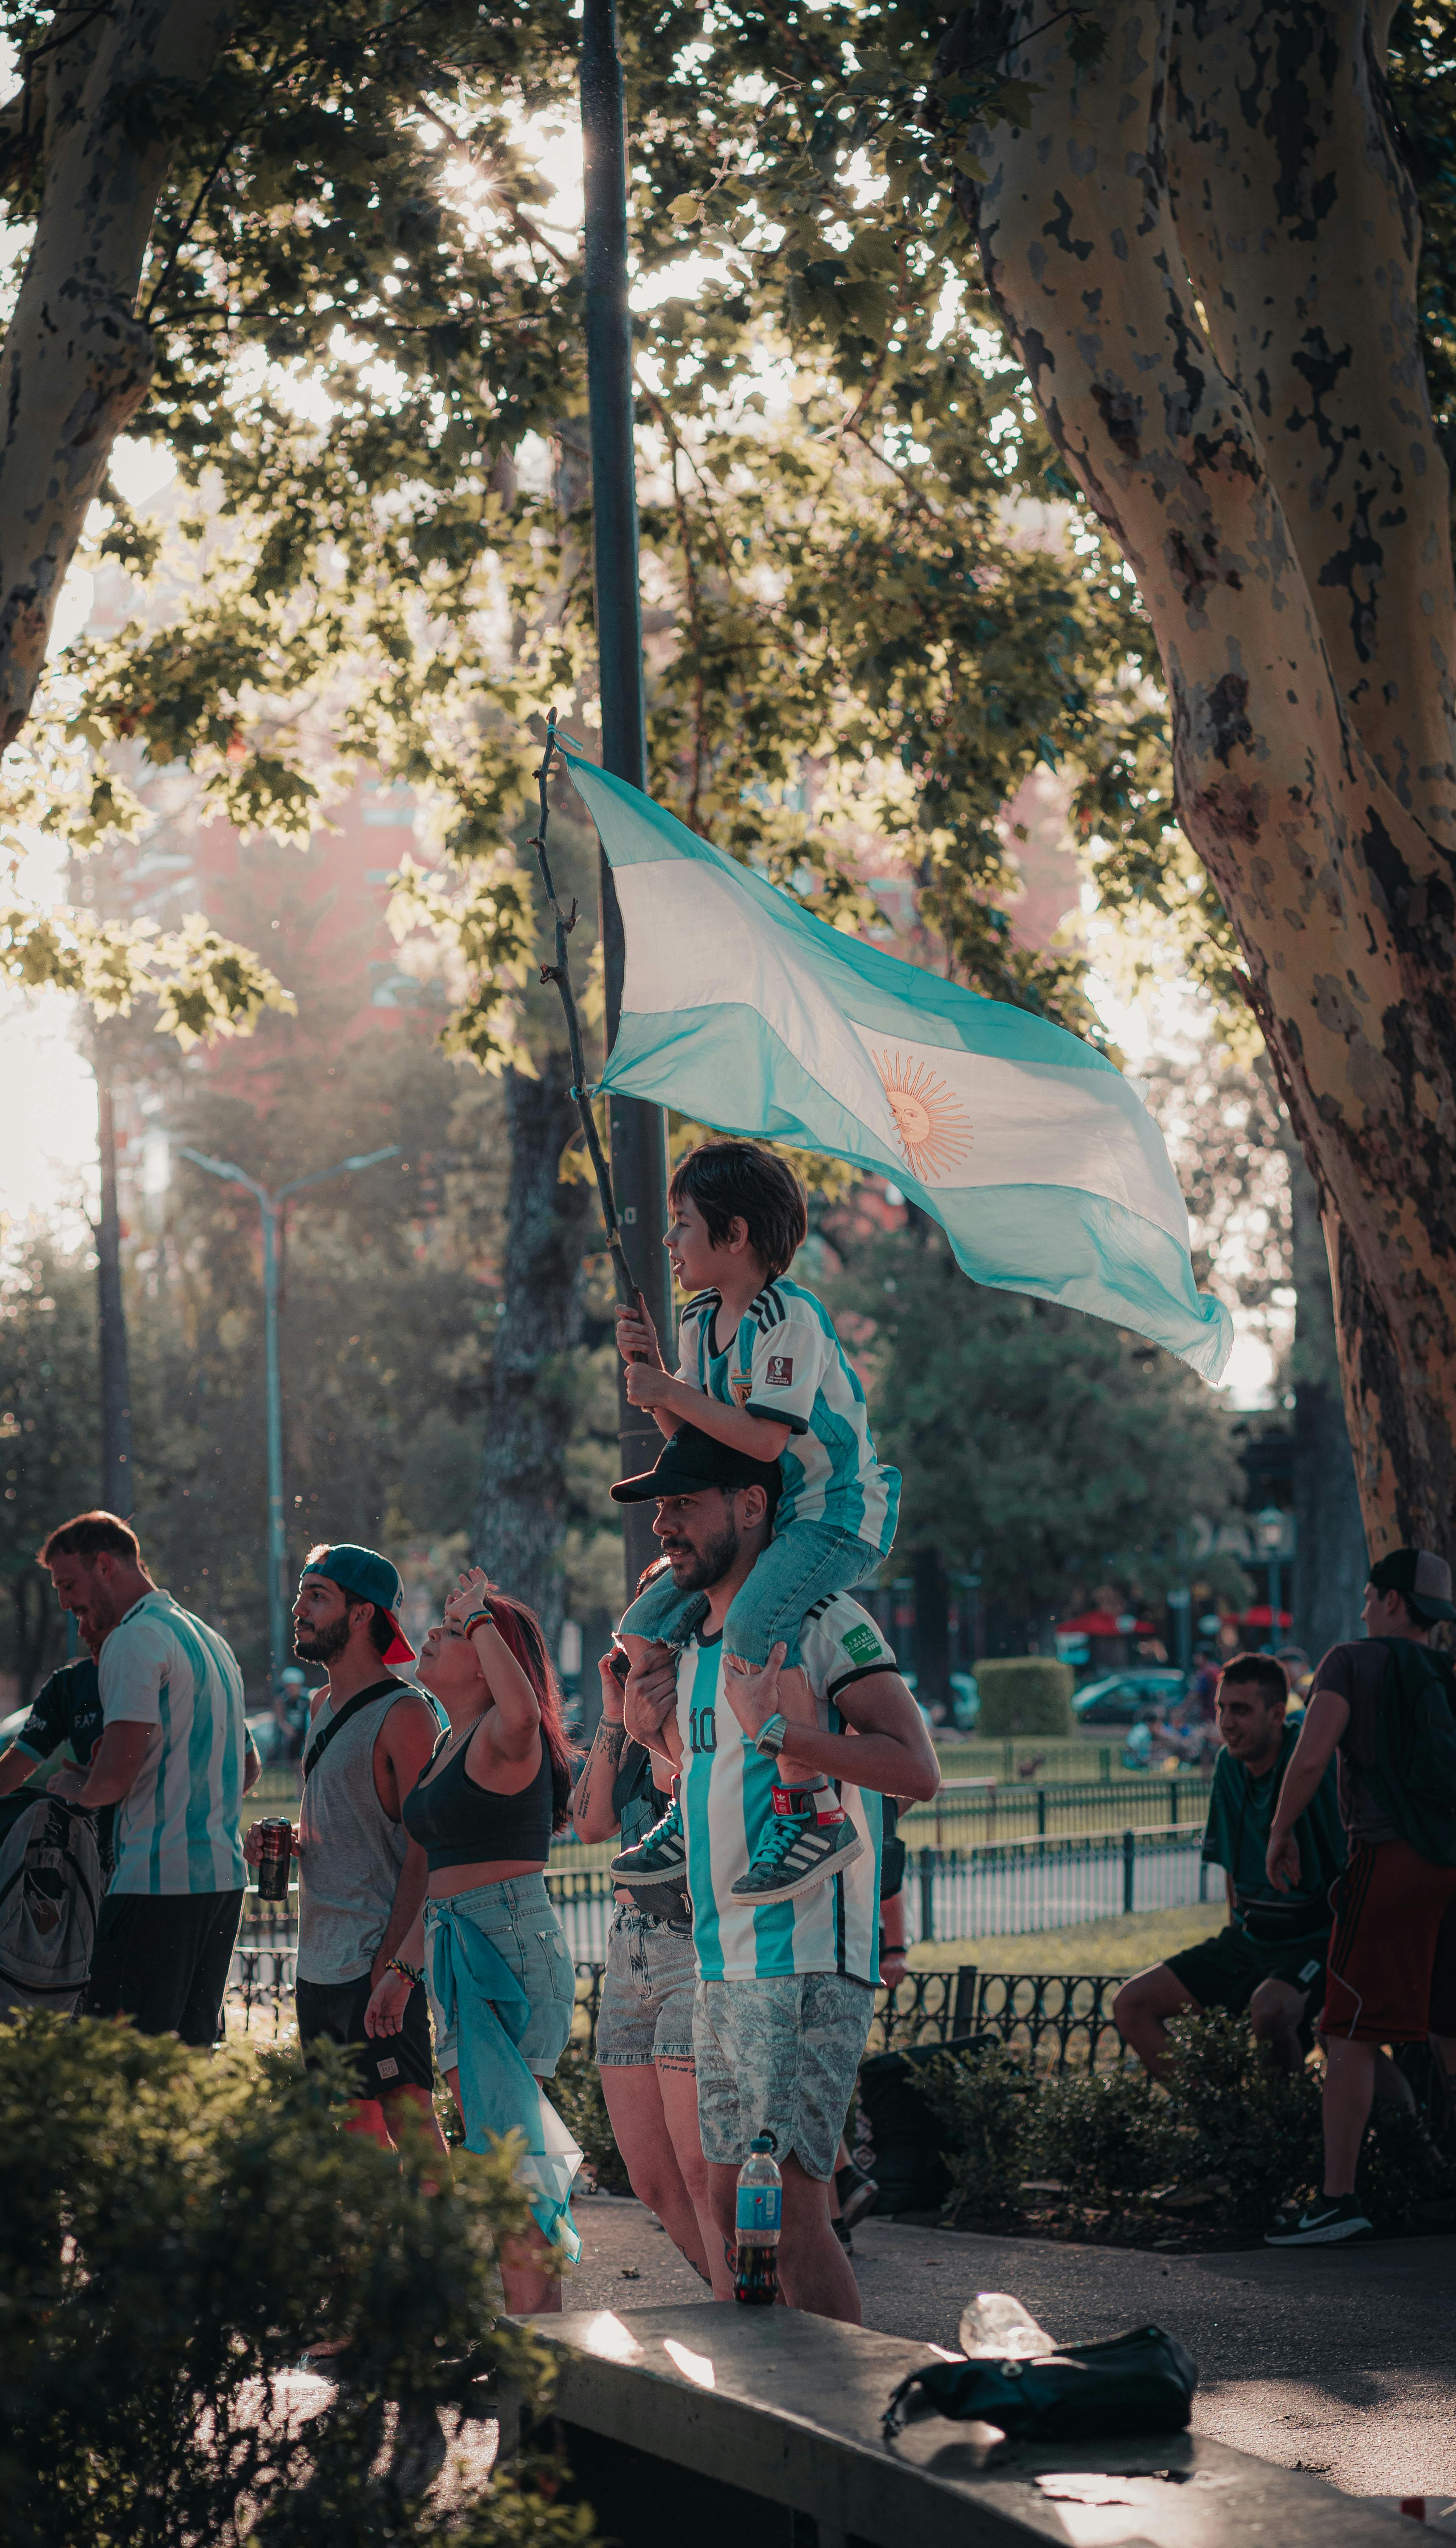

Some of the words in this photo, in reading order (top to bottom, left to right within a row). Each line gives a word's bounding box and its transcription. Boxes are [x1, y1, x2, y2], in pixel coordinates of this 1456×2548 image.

[844, 1629, 872, 1649] LIVING
[867, 1642, 880, 1652] FIFA
[689, 1707, 718, 1753] 10
